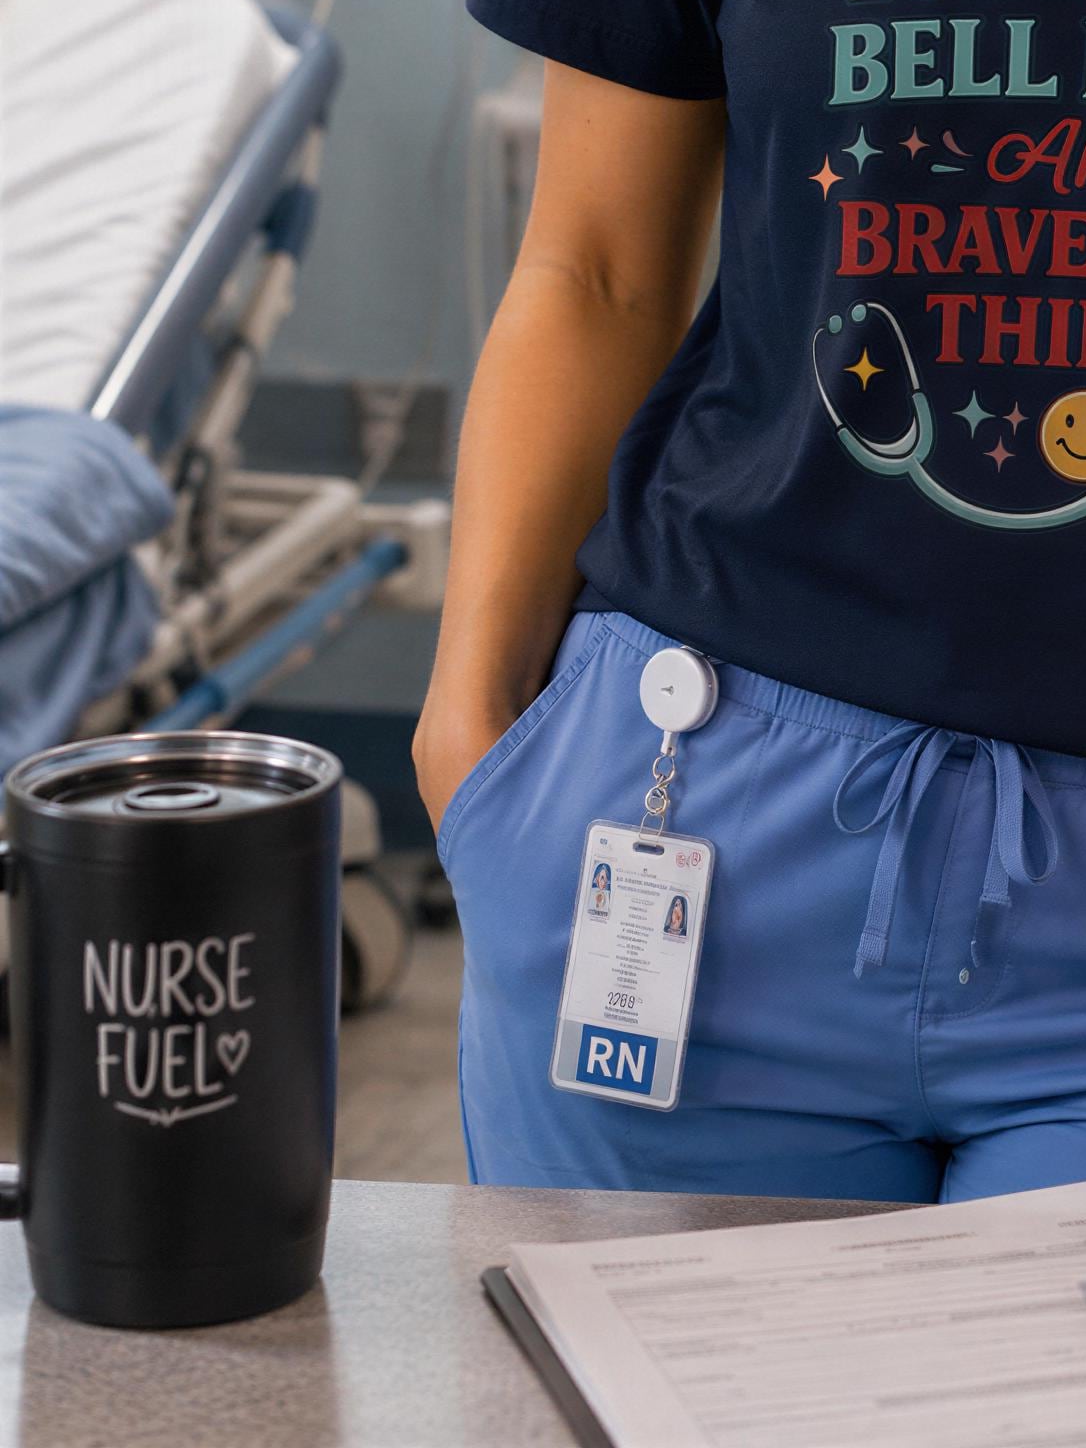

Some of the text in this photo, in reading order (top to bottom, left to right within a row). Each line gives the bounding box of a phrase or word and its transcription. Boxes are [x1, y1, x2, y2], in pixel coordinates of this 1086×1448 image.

[829, 20, 1057, 106] BELL
[84, 933, 254, 1017] NURSE
[97, 1023, 223, 1097] FUEL
[586, 1036, 647, 1084] RN
